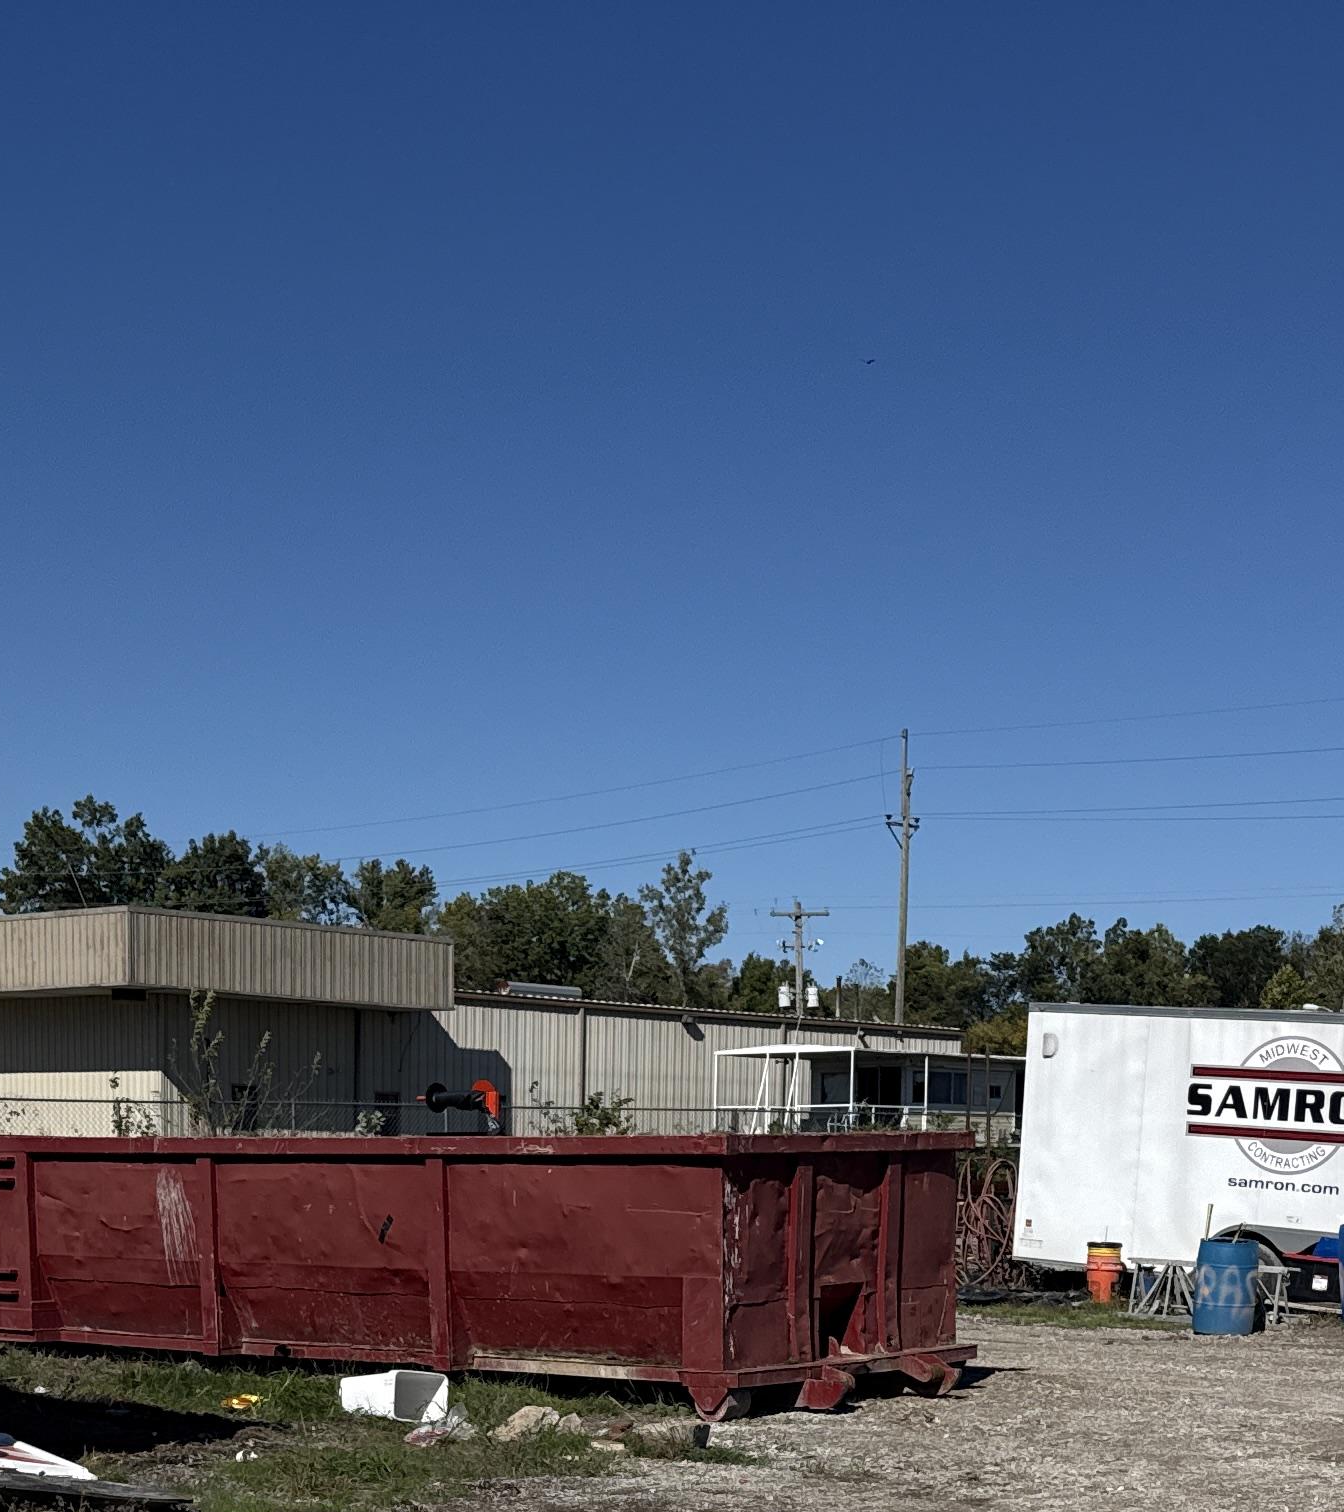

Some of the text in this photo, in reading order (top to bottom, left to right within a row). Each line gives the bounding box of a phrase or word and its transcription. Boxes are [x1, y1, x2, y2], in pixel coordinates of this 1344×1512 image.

[1259, 1043, 1330, 1066] MIDWEST
[1247, 1141, 1326, 1169] CONTRACTING
[1227, 1177, 1340, 1195] samron.com
